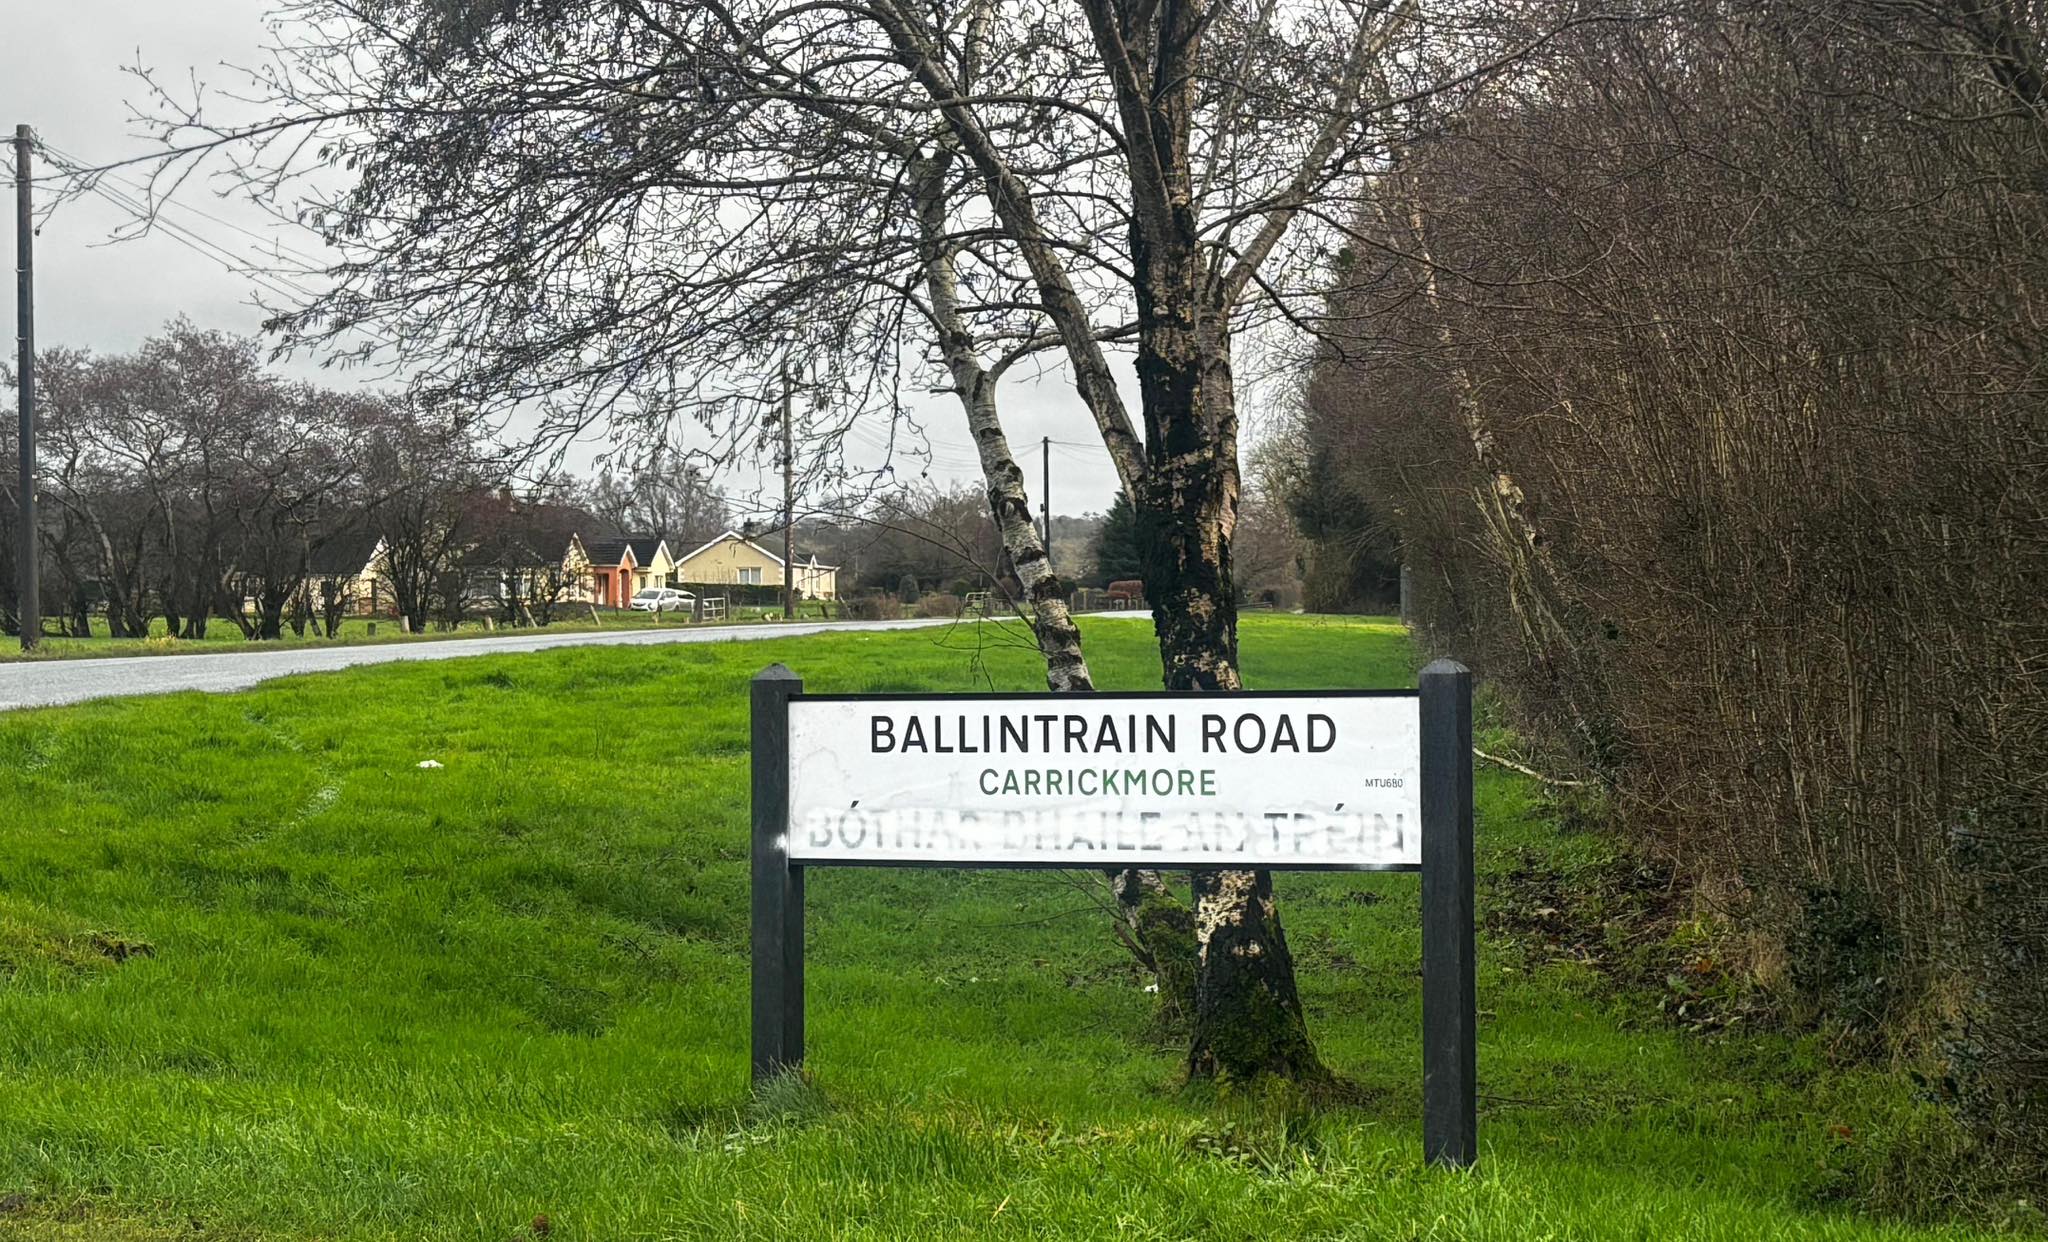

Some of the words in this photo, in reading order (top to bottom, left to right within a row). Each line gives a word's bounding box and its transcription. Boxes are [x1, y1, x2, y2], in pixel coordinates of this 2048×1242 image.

[871, 714, 1176, 754] BALLINTRAIN
[1201, 713, 1337, 754] ROAD
[979, 769, 1217, 796] CARRICKMORE
[1365, 778, 1404, 788] MTU680
